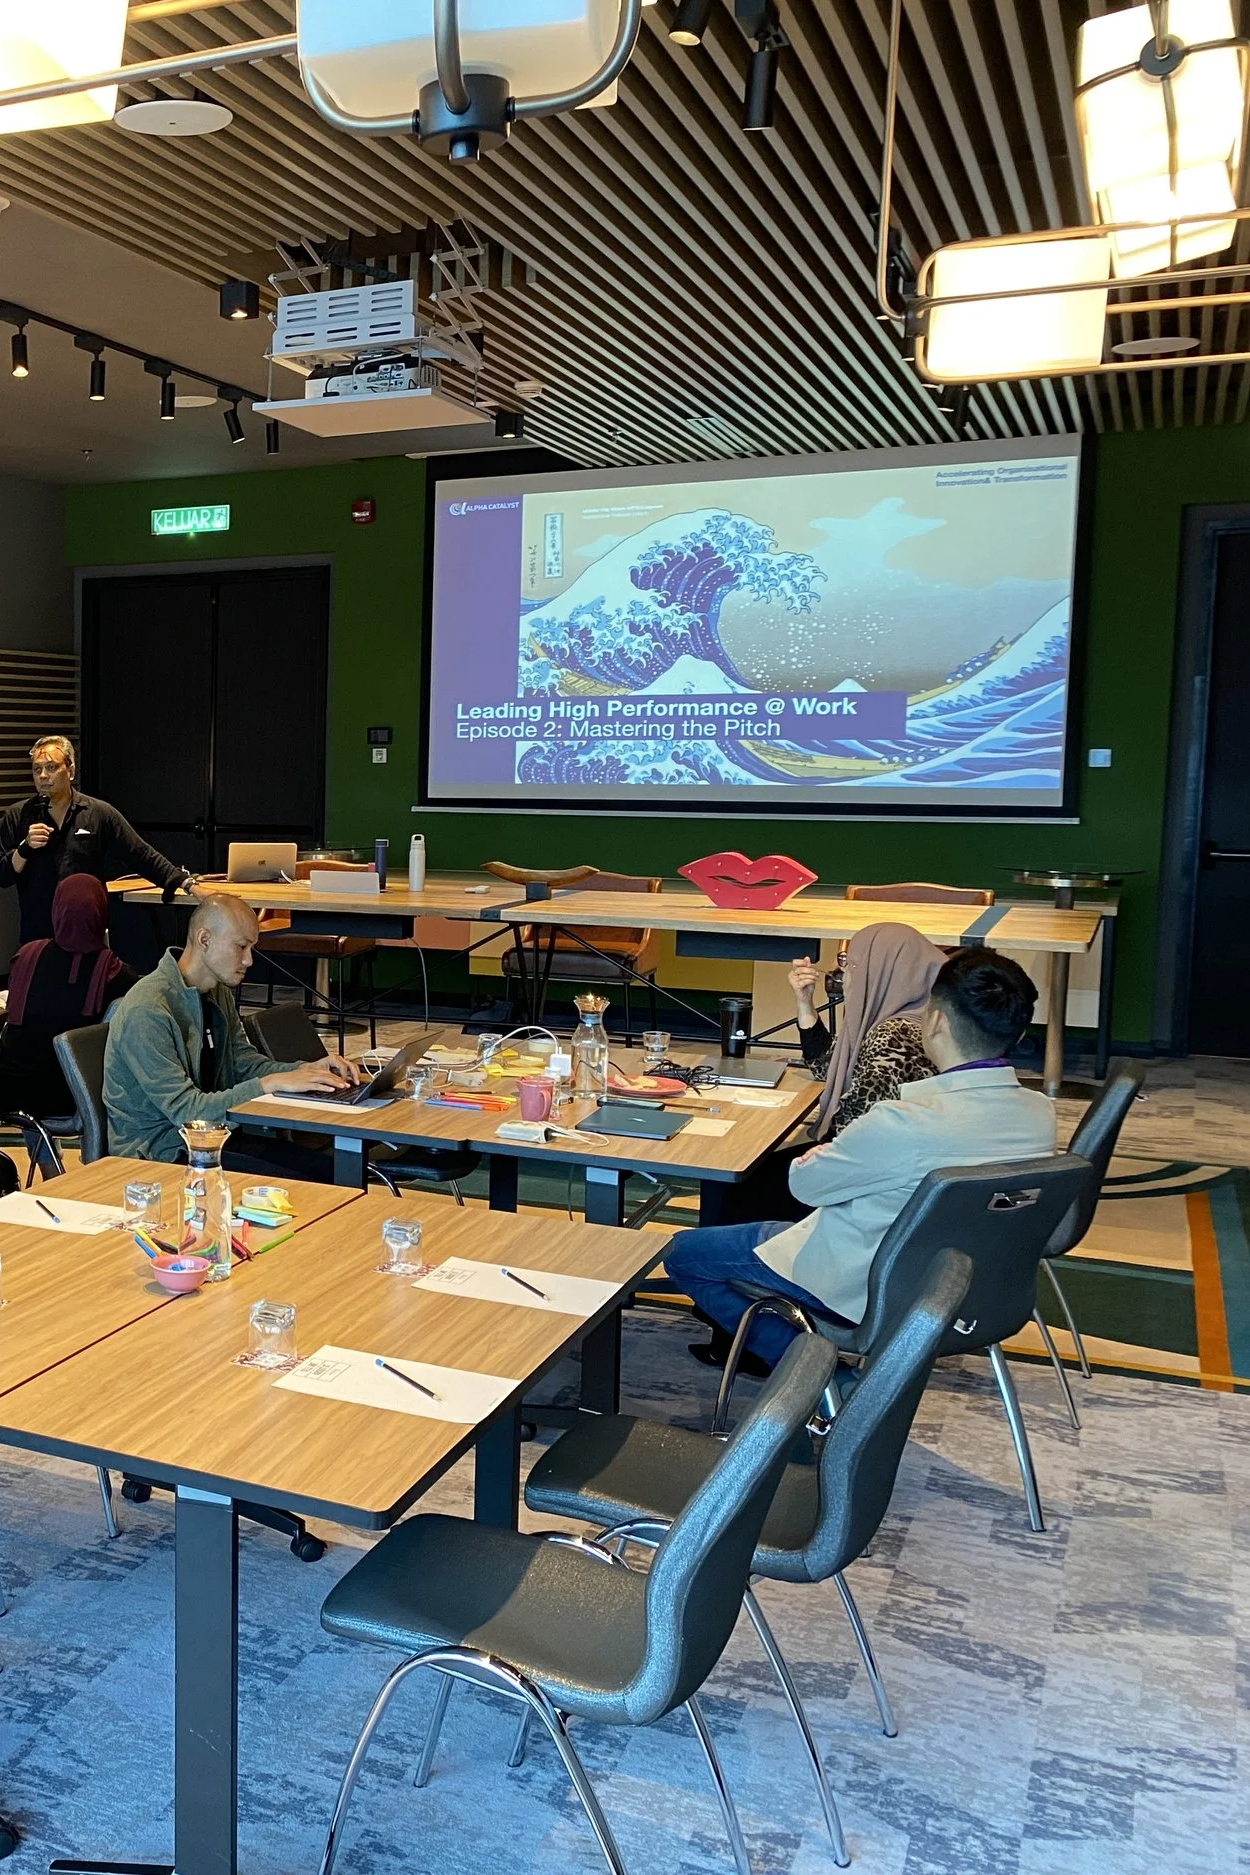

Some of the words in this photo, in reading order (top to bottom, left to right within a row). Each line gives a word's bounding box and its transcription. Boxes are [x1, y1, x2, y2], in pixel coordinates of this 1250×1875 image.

[466, 503, 488, 512] ALPHA
[488, 501, 520, 510] CATALYST
[153, 510, 211, 532] KELUAR
[456, 702, 542, 722] Leading
[550, 700, 600, 721] High
[606, 699, 758, 717] Performance
[764, 697, 786, 716] @
[791, 697, 858, 716] Work
[456, 722, 538, 742] Episode
[543, 720, 563, 738] 2:
[569, 719, 676, 741] Mastering
[681, 719, 718, 737] the
[724, 718, 781, 737] Pitch
